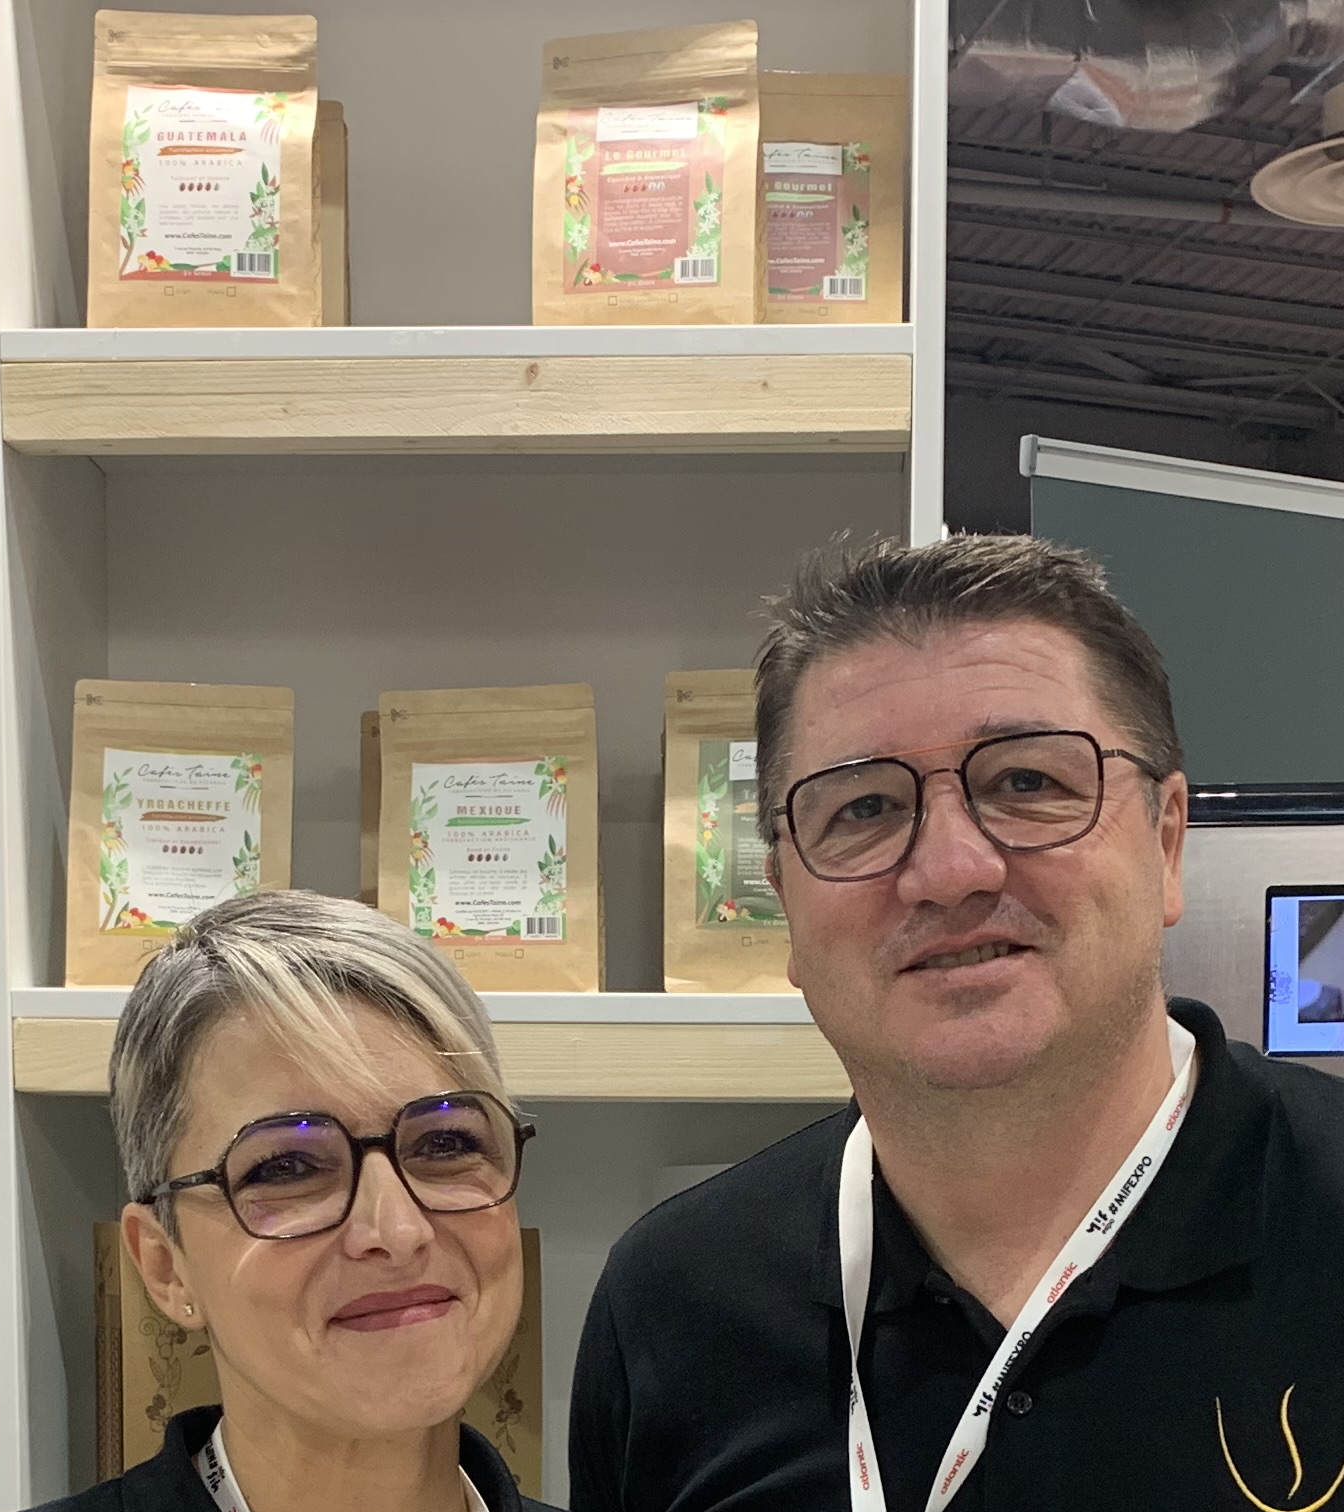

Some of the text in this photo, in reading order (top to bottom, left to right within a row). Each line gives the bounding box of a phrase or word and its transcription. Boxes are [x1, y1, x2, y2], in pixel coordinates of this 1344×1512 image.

[156, 130, 248, 143] GUATEMALA
[605, 150, 621, 161] Le
[774, 181, 833, 192] Gourmet
[444, 773, 536, 789] Cafés Taine
[137, 798, 232, 812] YRGACHEFFE
[457, 805, 522, 815] MEXIQUE
[1108, 1155, 1152, 1216] #MIFEXPO
[1047, 1262, 1078, 1304] atlantic
[856, 1441, 870, 1491] atlantic
[940, 1448, 970, 1496] atlantic
